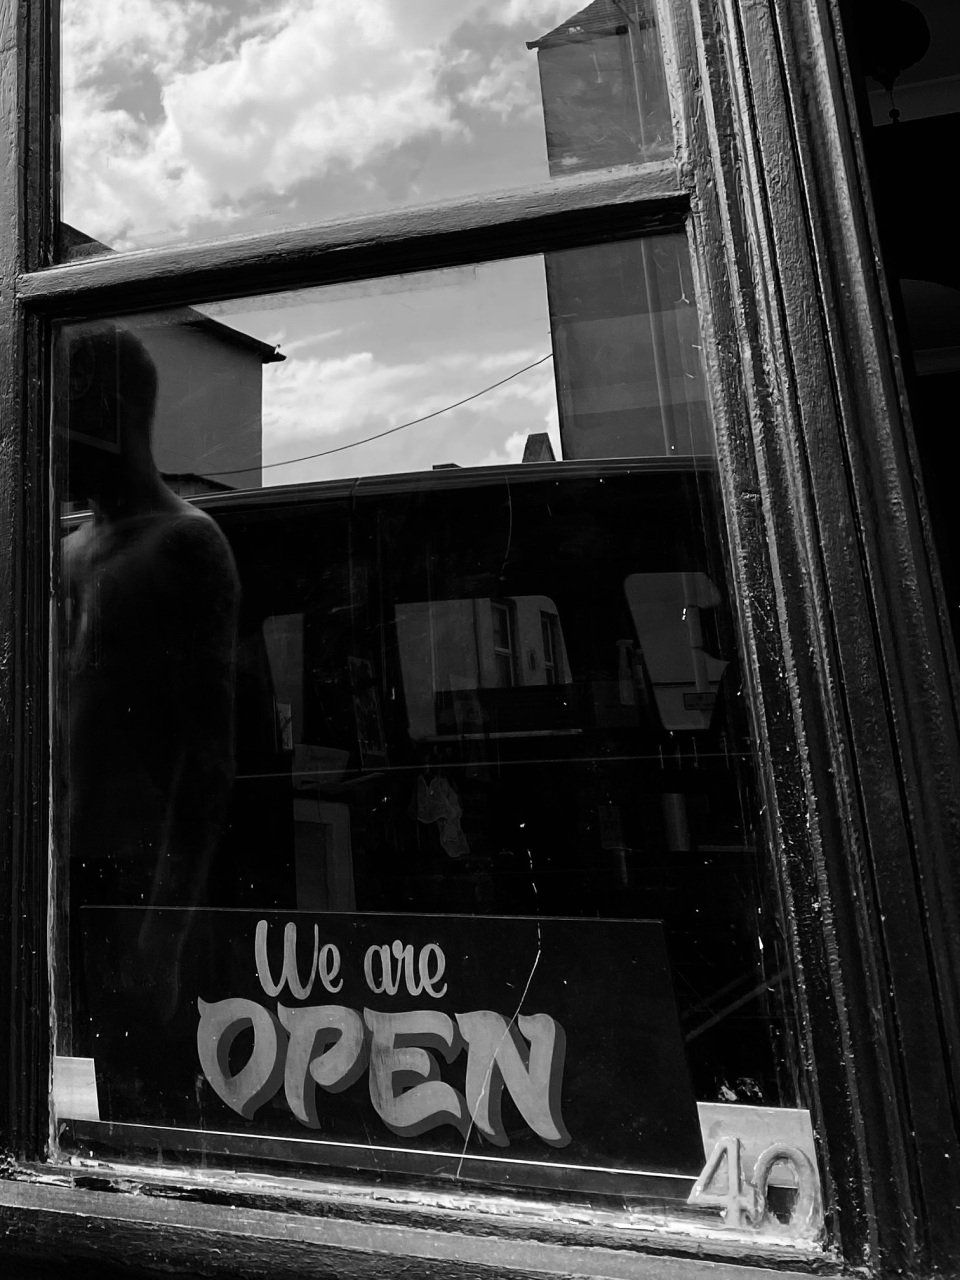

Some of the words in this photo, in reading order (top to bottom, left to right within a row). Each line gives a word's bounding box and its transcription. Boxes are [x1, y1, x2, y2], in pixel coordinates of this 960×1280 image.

[254, 918, 345, 1001] We
[363, 938, 448, 1000] are
[196, 995, 568, 1147] OPEN
[686, 1136, 824, 1232] 40
